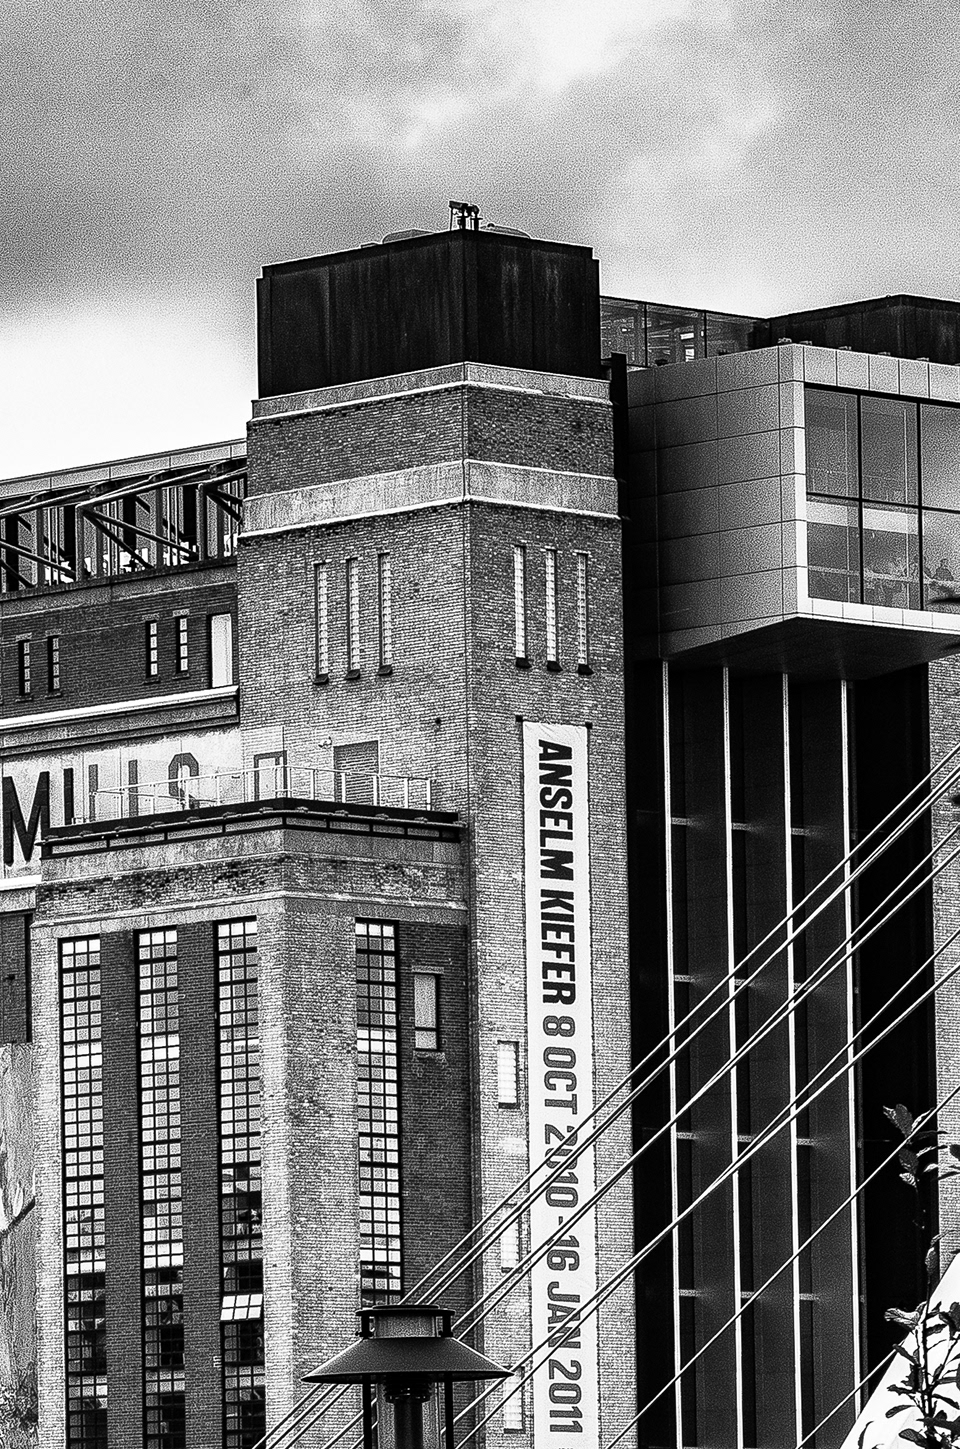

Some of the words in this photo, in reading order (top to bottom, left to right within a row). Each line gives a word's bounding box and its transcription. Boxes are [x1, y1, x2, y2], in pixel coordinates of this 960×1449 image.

[538, 738, 574, 881] ANSELM
[540, 888, 576, 1005] KIEFER
[543, 1015, 576, 1037] 8
[543, 1046, 578, 1115] OCT
[544, 1123, 579, 1208] 2010
[546, 1234, 581, 1272] 16
[547, 1281, 581, 1349] JAN
[548, 1358, 583, 1433] 2011
